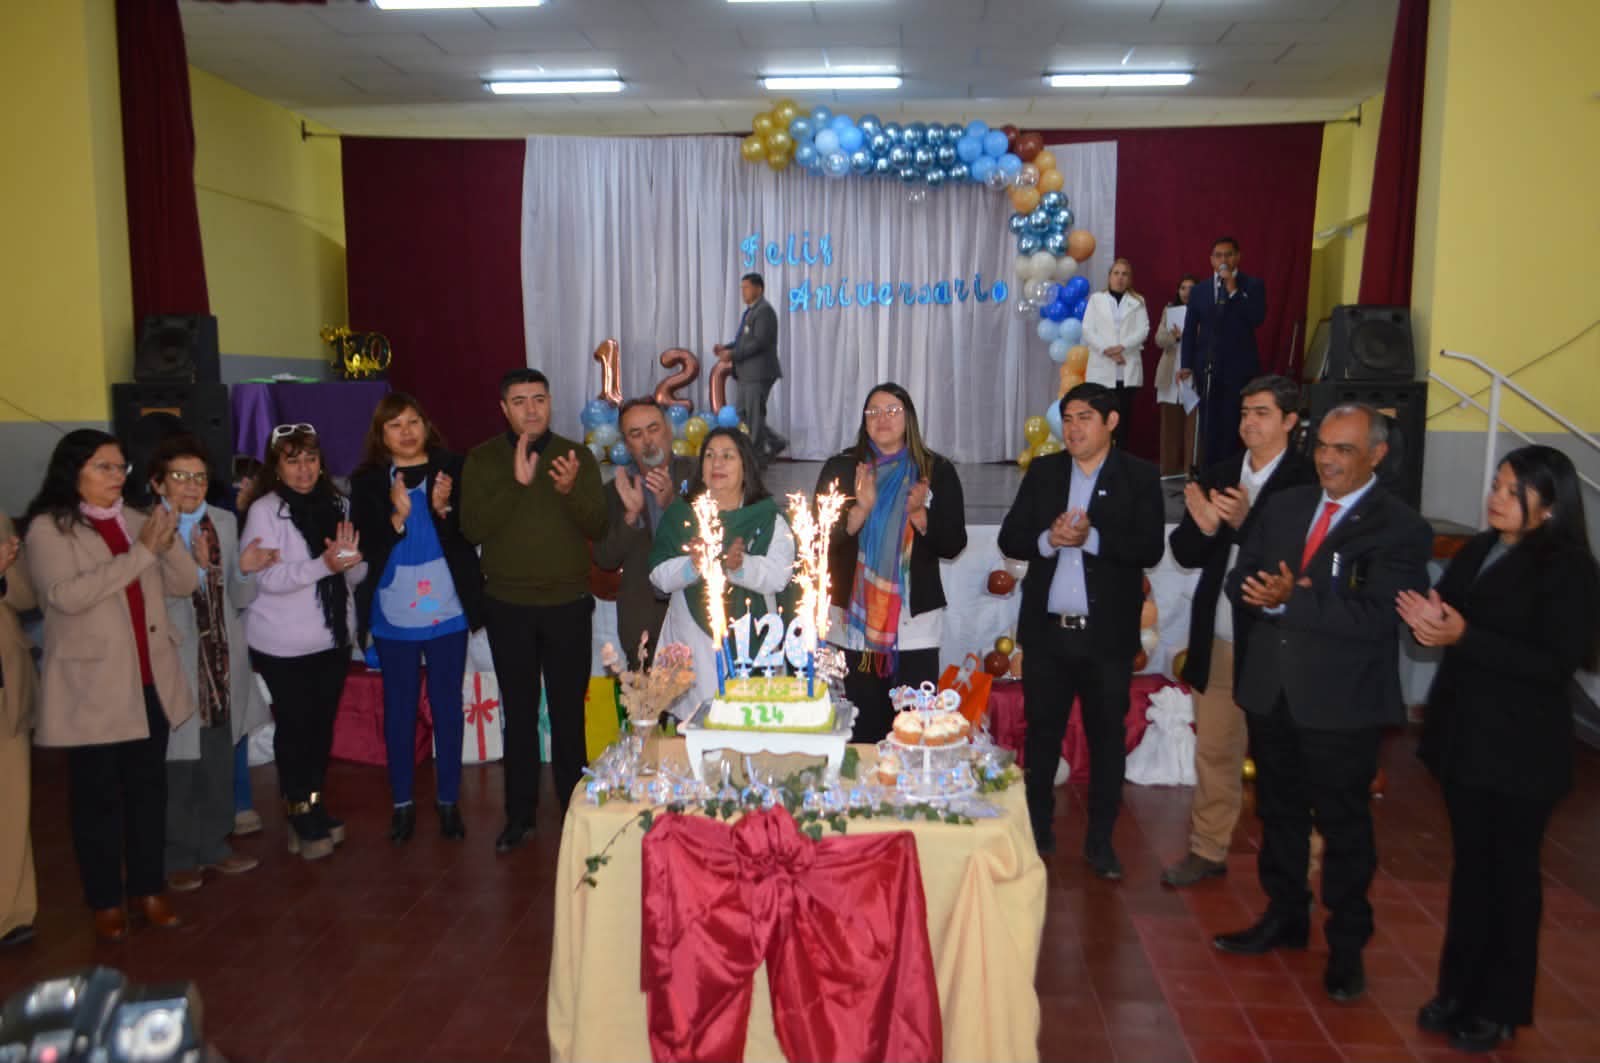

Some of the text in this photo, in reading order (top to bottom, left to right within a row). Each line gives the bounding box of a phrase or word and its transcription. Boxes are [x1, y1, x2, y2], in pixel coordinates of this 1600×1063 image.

[739, 230, 833, 267] Feliz
[788, 273, 1009, 312] Aniversario
[729, 613, 816, 668] 120
